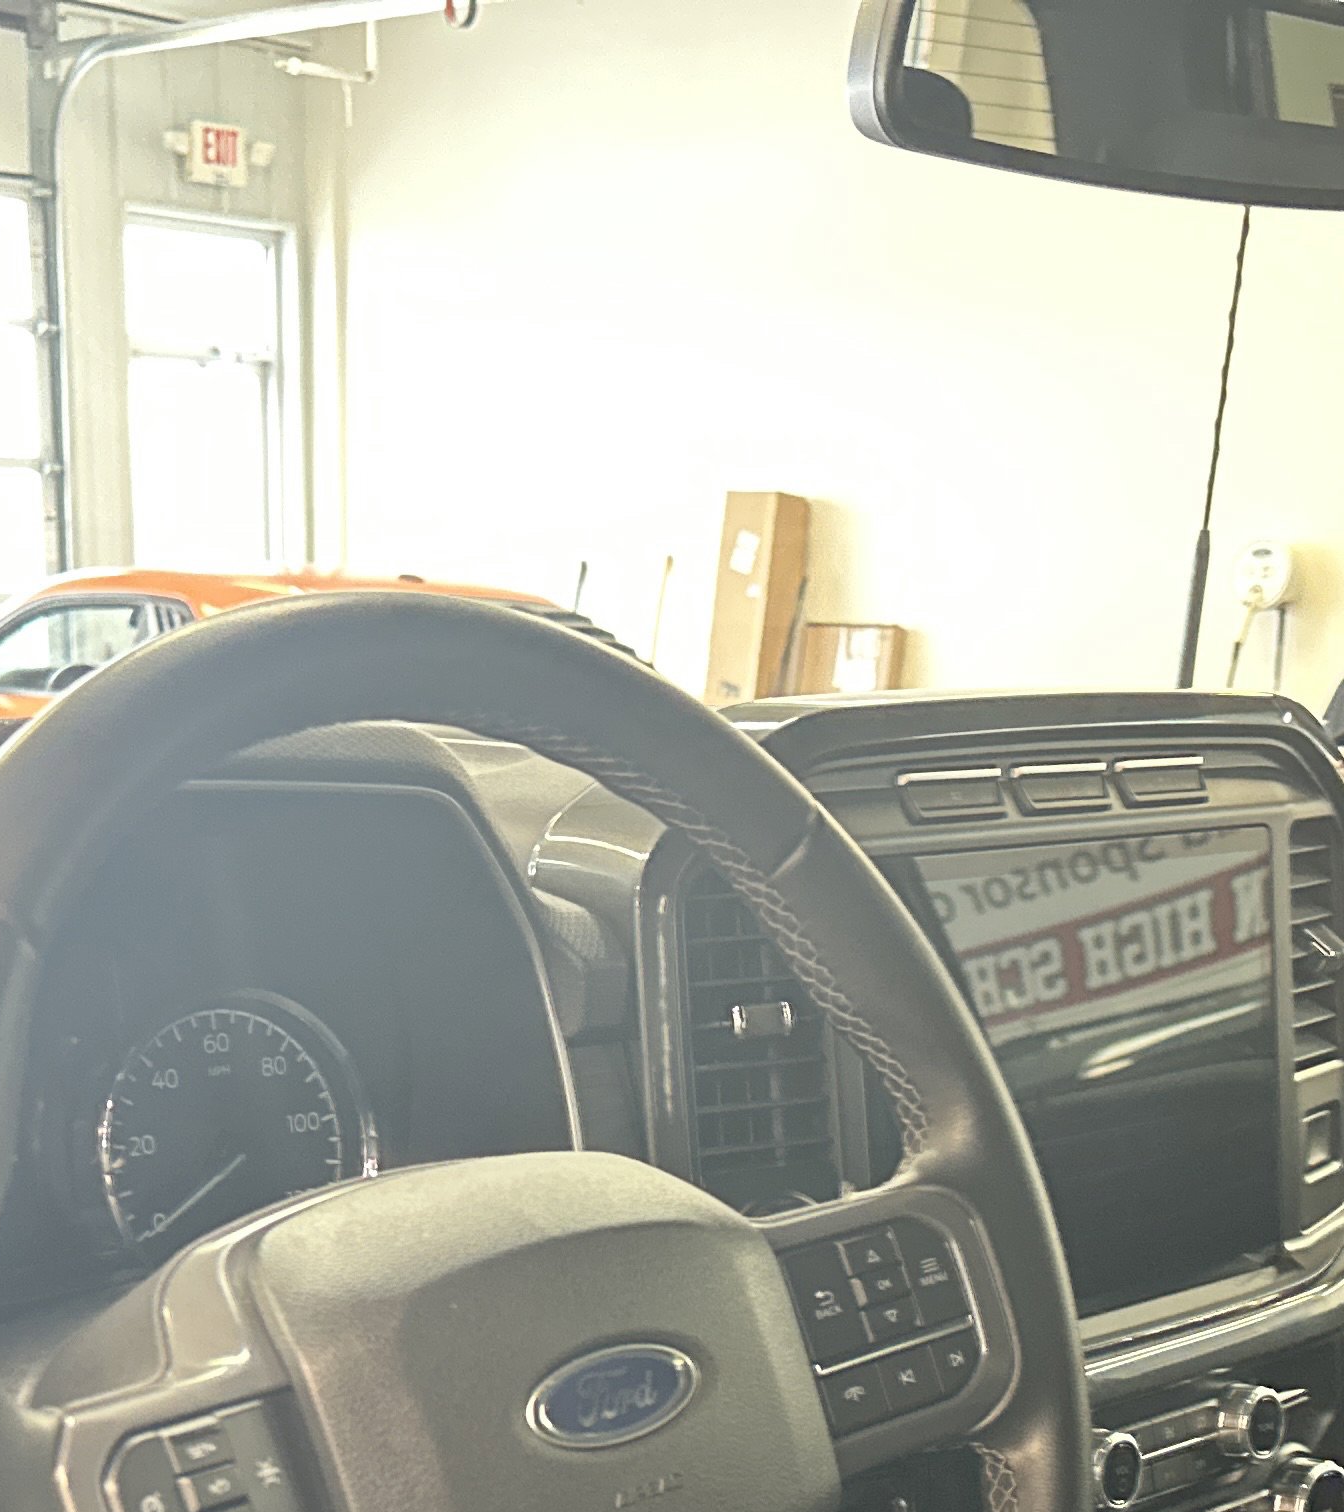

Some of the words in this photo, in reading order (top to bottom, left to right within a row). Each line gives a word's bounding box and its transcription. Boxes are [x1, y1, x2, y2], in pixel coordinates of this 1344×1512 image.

[203, 1032, 229, 1053] 60
[261, 1056, 287, 1077] 80
[151, 1068, 179, 1089] 40
[286, 1112, 320, 1133] 100
[129, 1135, 155, 1157] 20
